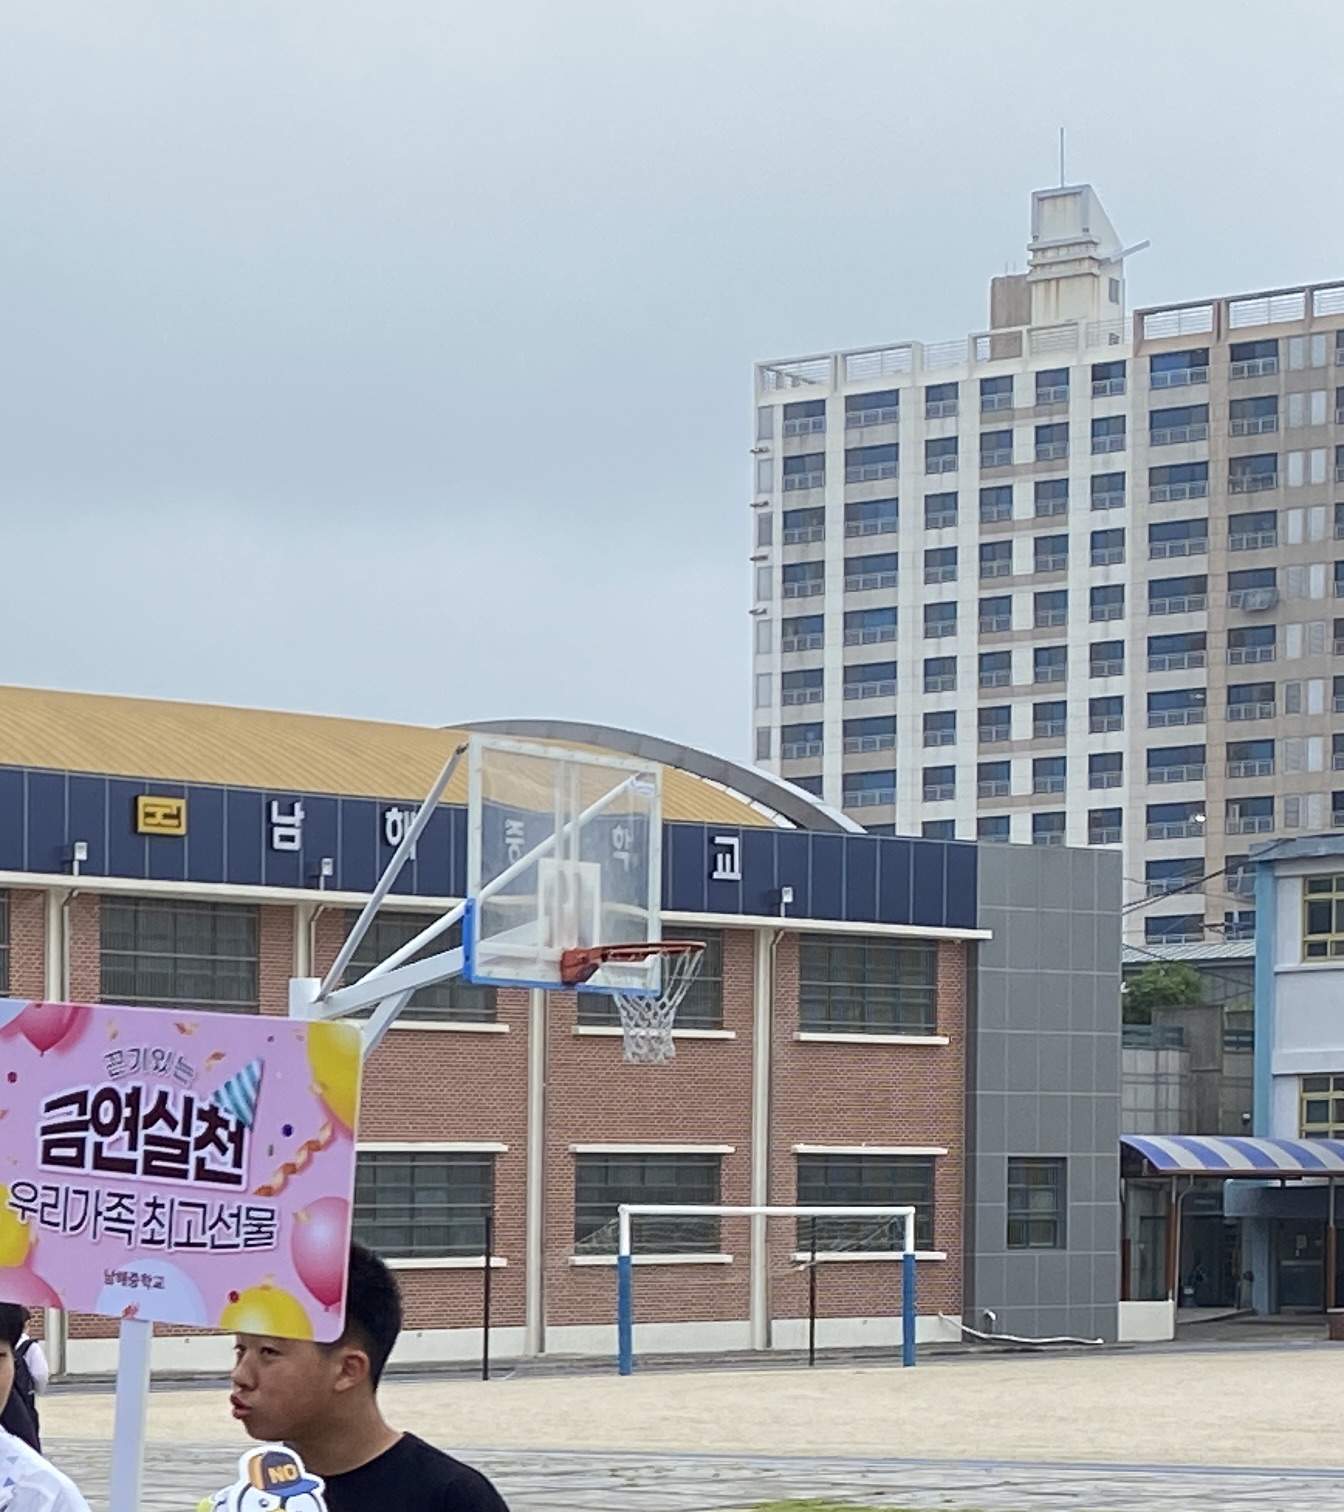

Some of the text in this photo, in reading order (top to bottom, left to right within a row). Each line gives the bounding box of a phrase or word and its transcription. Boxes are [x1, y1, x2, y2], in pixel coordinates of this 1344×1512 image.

[40, 1084, 248, 1187] 금연실천
[8, 1181, 279, 1250] 우리가족 최고선물
[103, 1268, 166, 1291] 남해중학교
